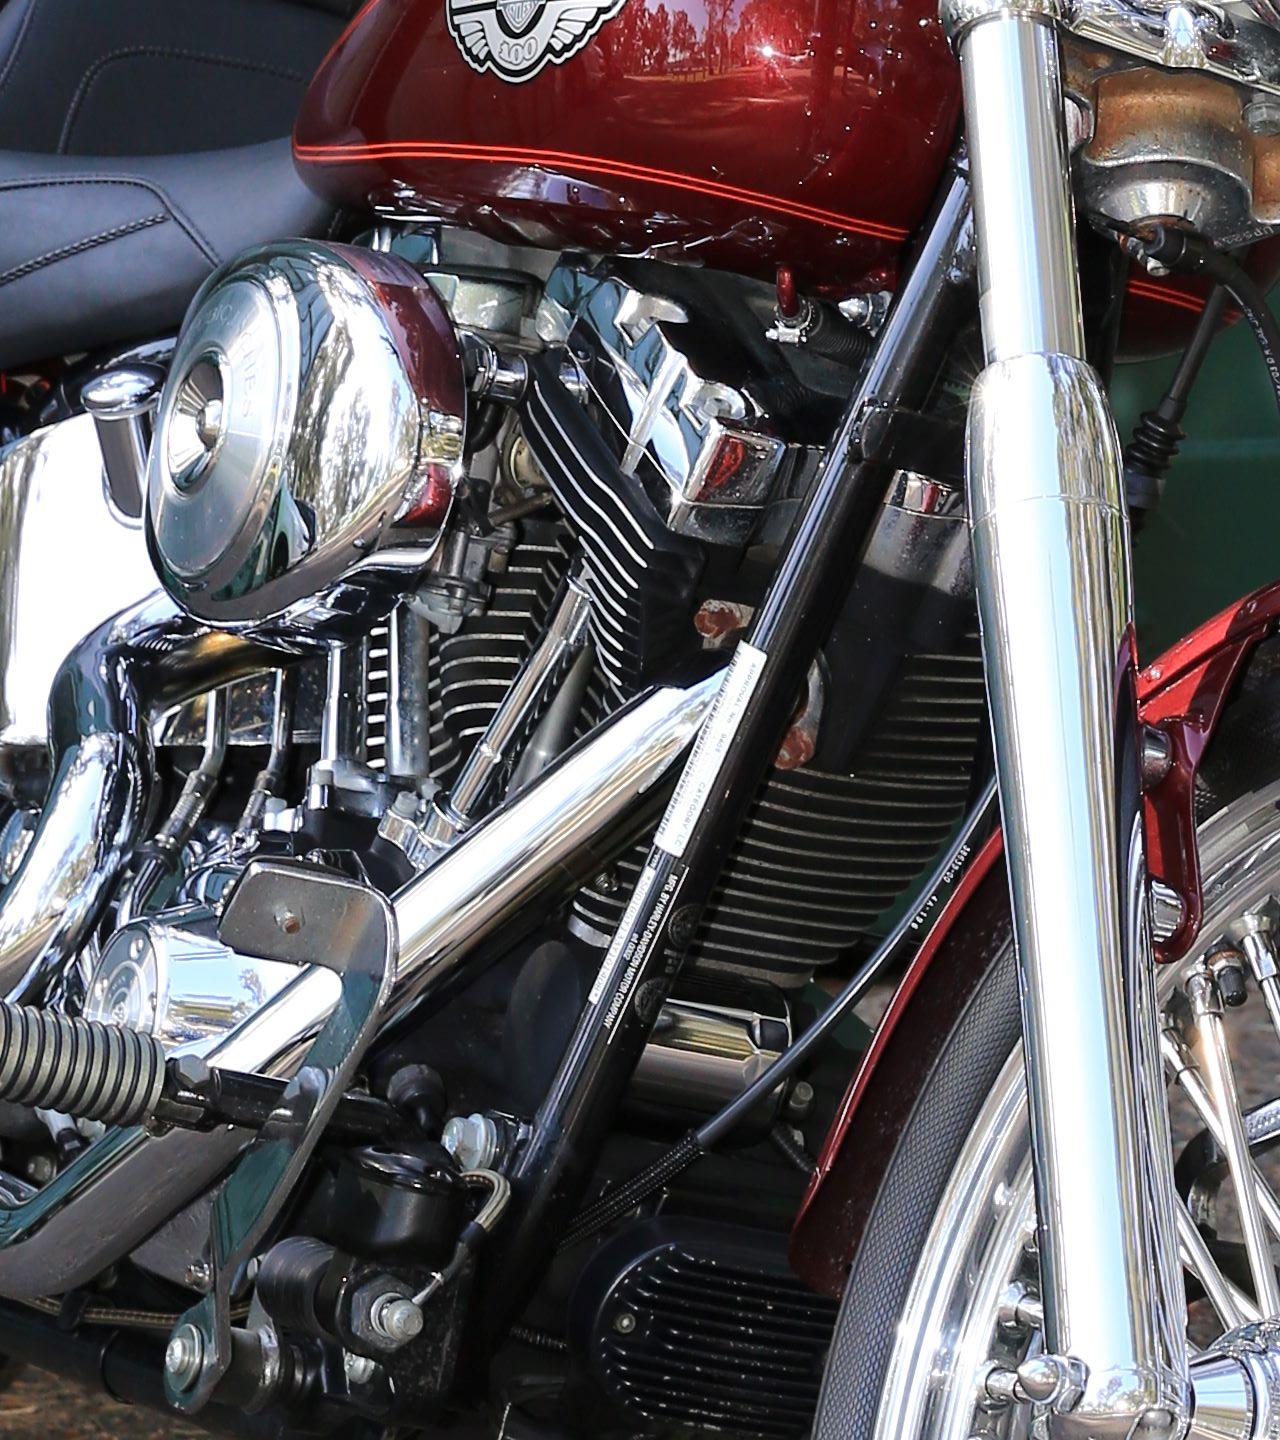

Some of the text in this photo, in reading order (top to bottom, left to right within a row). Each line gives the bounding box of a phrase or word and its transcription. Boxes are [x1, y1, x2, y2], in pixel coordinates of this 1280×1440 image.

[498, 37, 538, 65] 100
[662, 892, 671, 906] BY
[634, 899, 666, 969] HARLEY-DAVIDSON
[619, 962, 637, 995] MOTOR
[603, 991, 626, 1030] COMPANY
